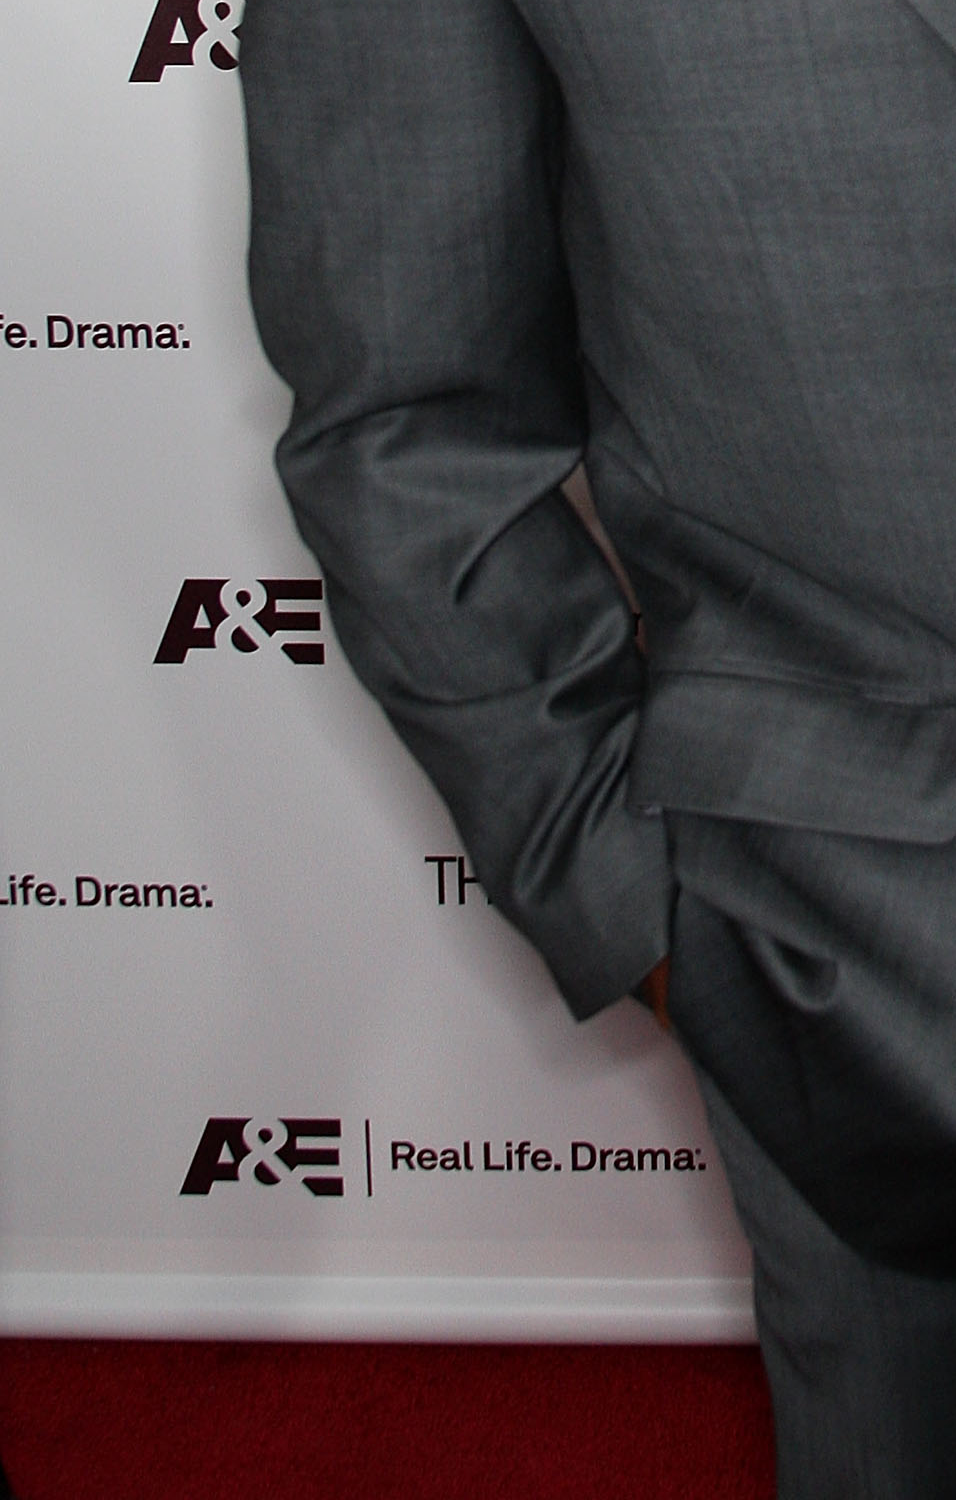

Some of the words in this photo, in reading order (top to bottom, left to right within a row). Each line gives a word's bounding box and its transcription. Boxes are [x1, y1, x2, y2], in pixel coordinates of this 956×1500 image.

[153, 579, 324, 664] A&E
[180, 1118, 343, 1196] A&E
[392, 1142, 473, 1170] Real
[484, 1142, 561, 1171] Life.
